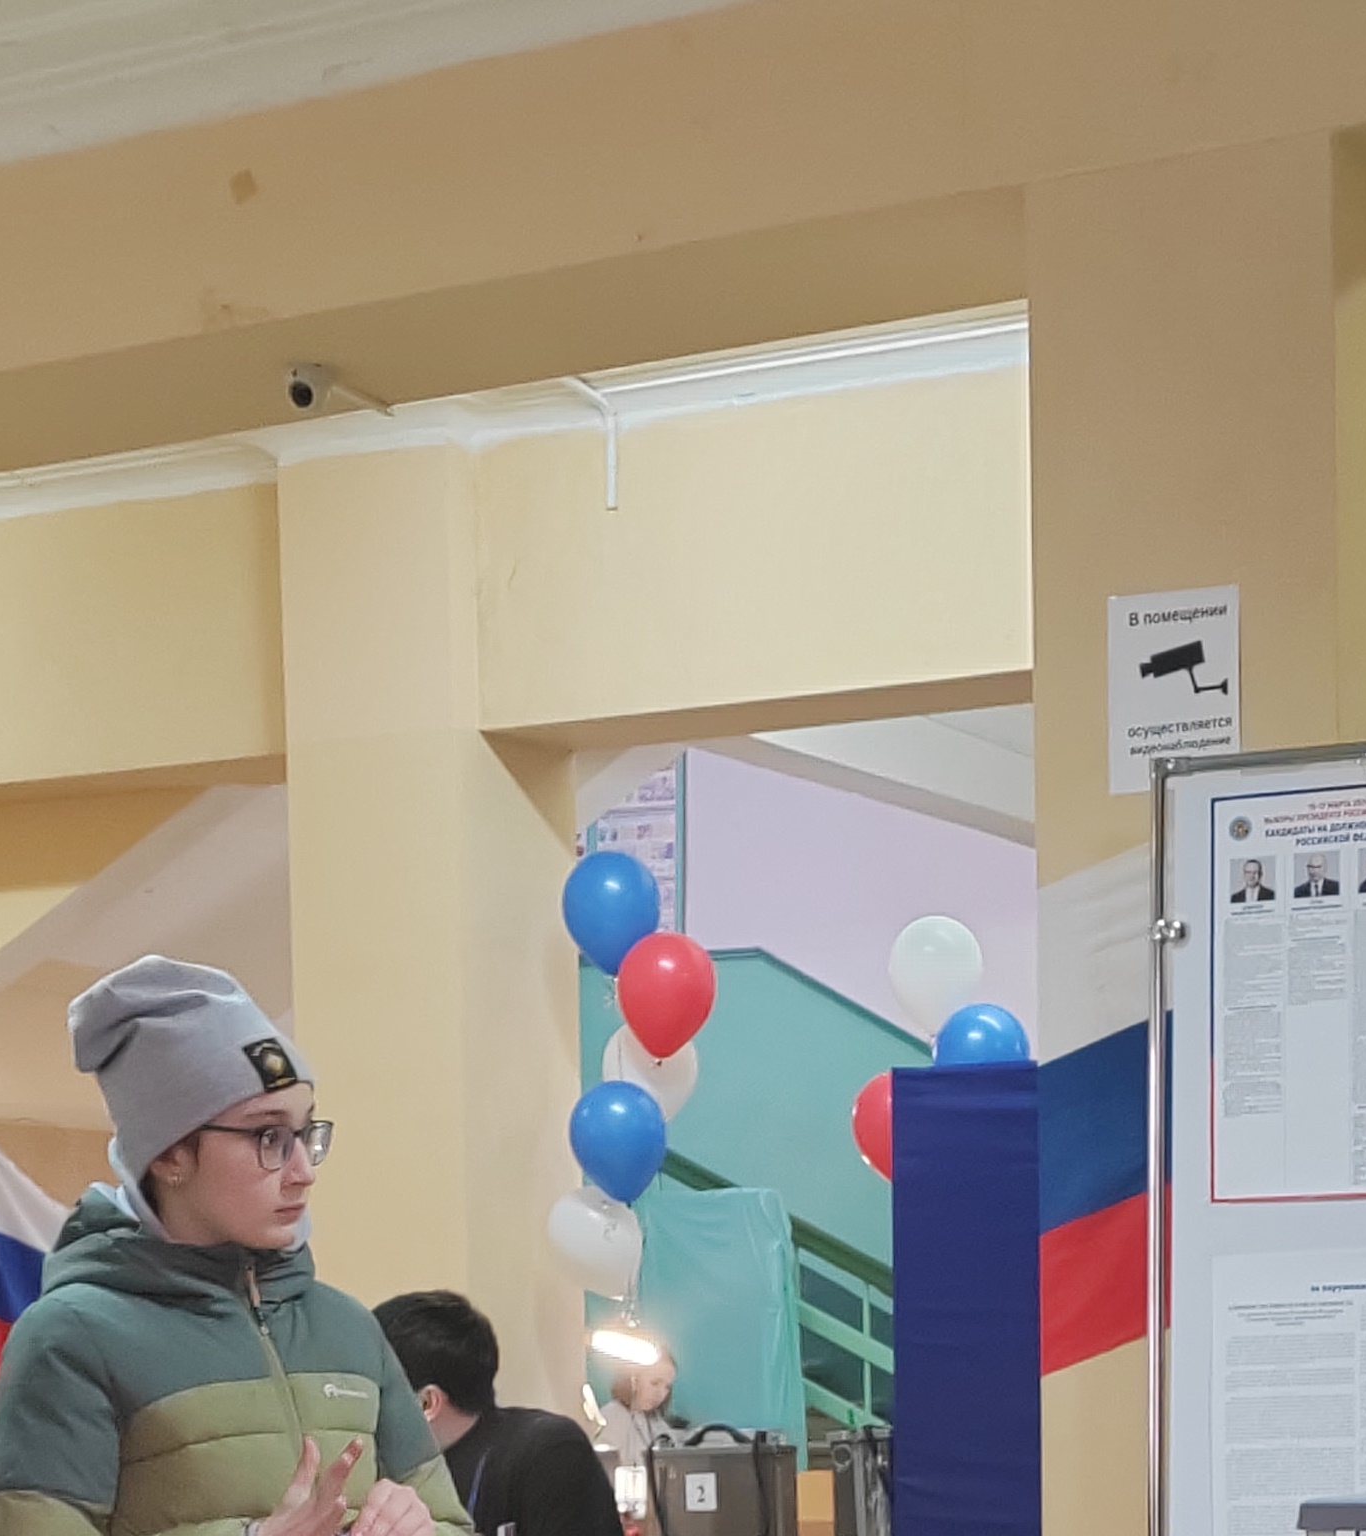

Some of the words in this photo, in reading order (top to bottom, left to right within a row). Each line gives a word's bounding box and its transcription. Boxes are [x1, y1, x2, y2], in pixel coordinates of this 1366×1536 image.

[1129, 612, 1140, 626] В
[1143, 605, 1227, 626] помещении
[1128, 716, 1232, 739] осуществляется
[697, 1485, 705, 1503] 2
